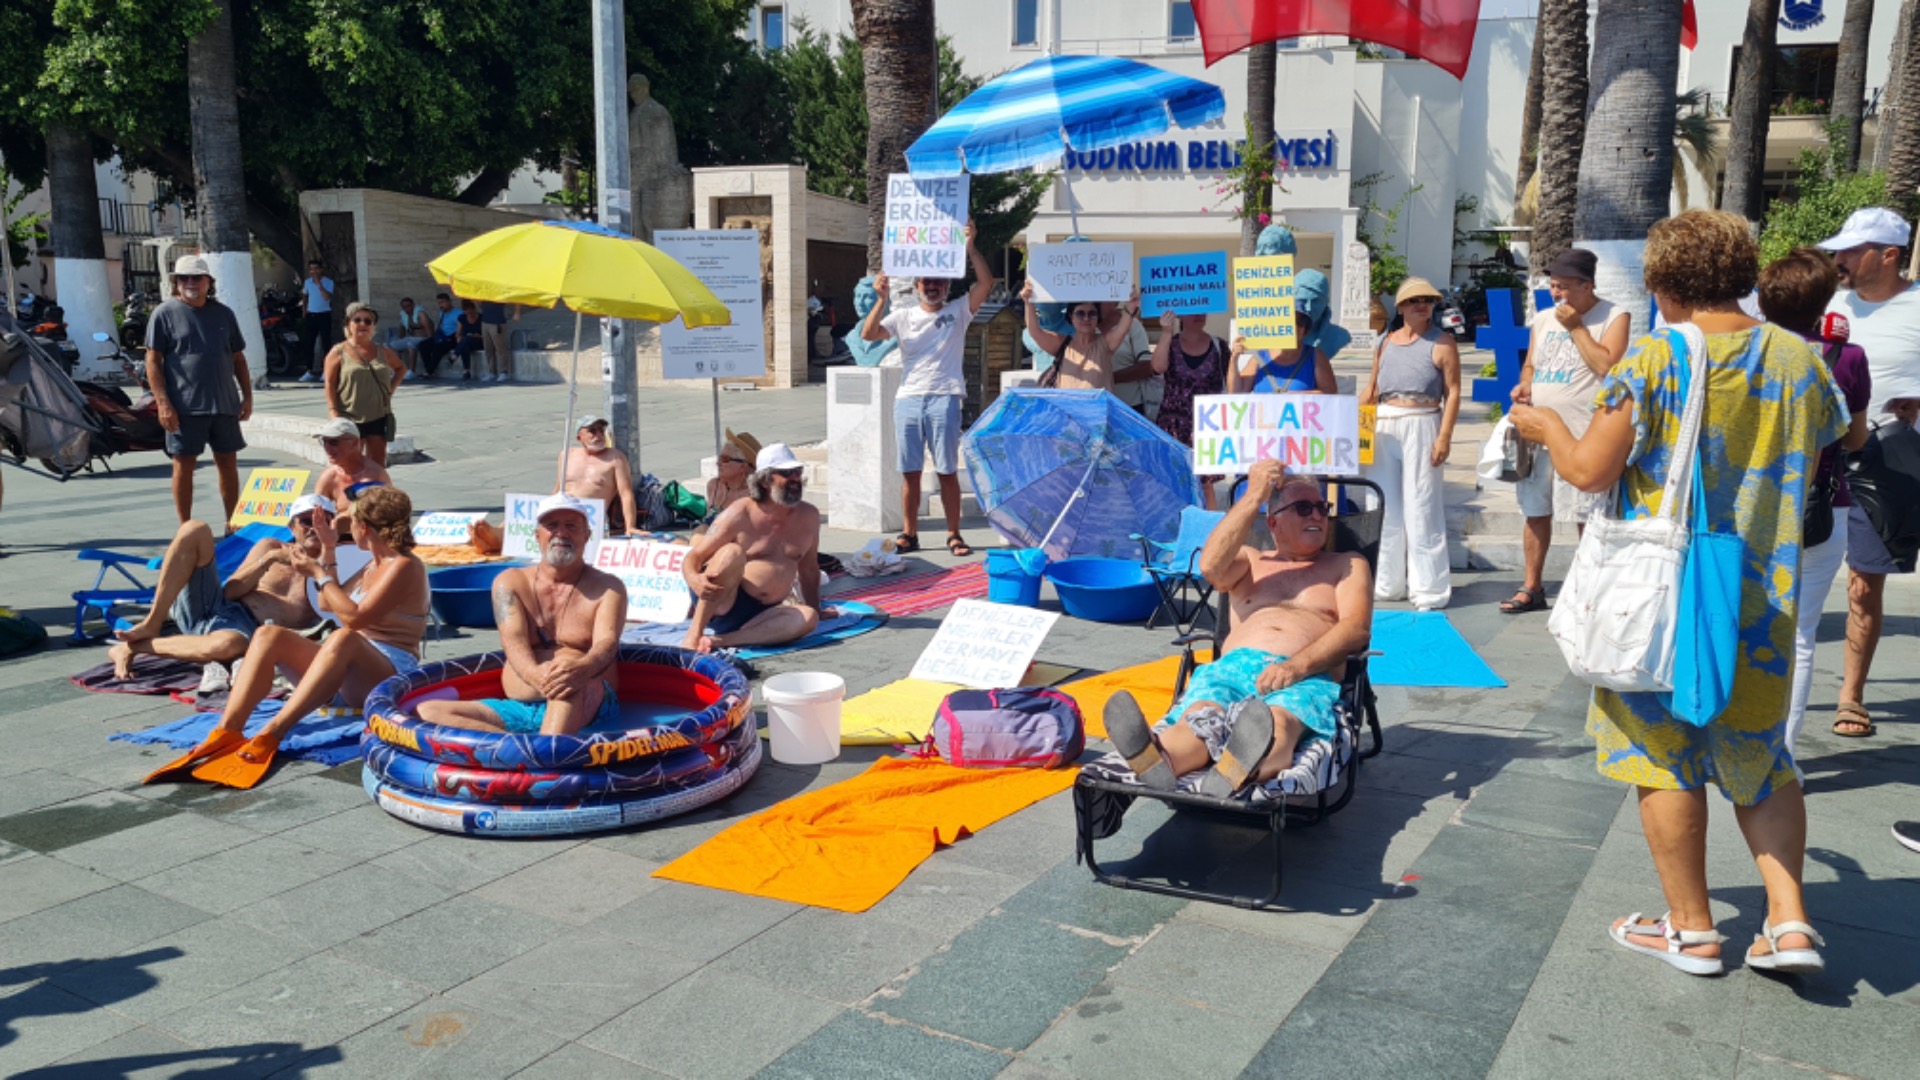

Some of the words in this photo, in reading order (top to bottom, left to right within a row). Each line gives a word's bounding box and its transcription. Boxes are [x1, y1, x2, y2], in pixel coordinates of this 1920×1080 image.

[1188, 129, 1332, 169] BELEYESİ
[893, 249, 956, 269] HAKKI
[1048, 252, 1081, 267] RANT
[1151, 263, 1218, 279] KIYILAR
[1236, 265, 1292, 279] DENİZLER
[1199, 280, 1226, 292] MALI
[1237, 285, 1294, 299] NEHİRLER
[1238, 306, 1290, 318] SERMAYE
[1198, 402, 1324, 431] KIYILAR
[1197, 436, 1356, 467] HALKINDIR
[253, 478, 296, 492] KIYILAR
[653, 550, 684, 576] ÇE
